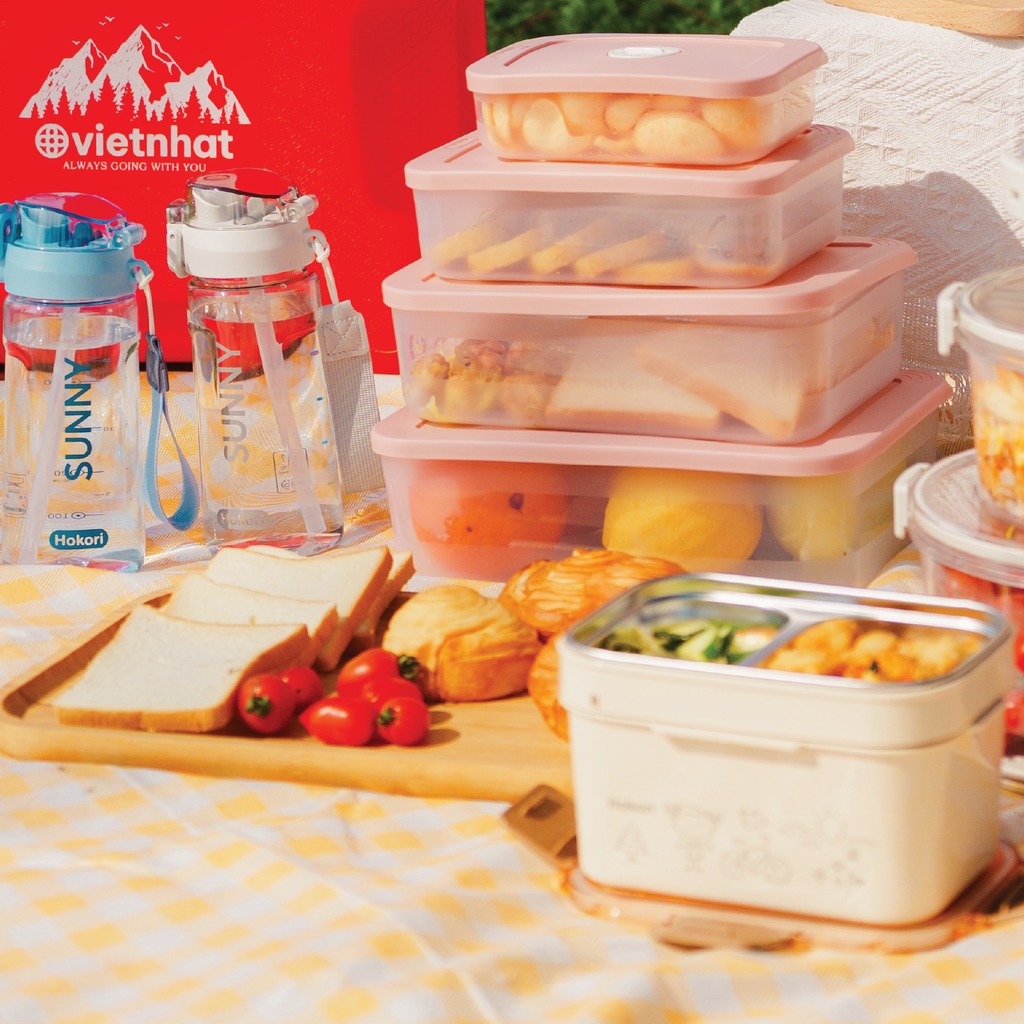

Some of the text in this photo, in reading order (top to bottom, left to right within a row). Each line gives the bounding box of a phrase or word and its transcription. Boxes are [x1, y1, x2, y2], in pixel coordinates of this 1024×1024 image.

[71, 122, 234, 159] vietnhat
[63, 161, 207, 172] ALWAYS GOING WITH YOU
[64, 357, 92, 481] SUNNY
[216, 341, 249, 464] SUNNY
[54, 532, 104, 547] Hokori
